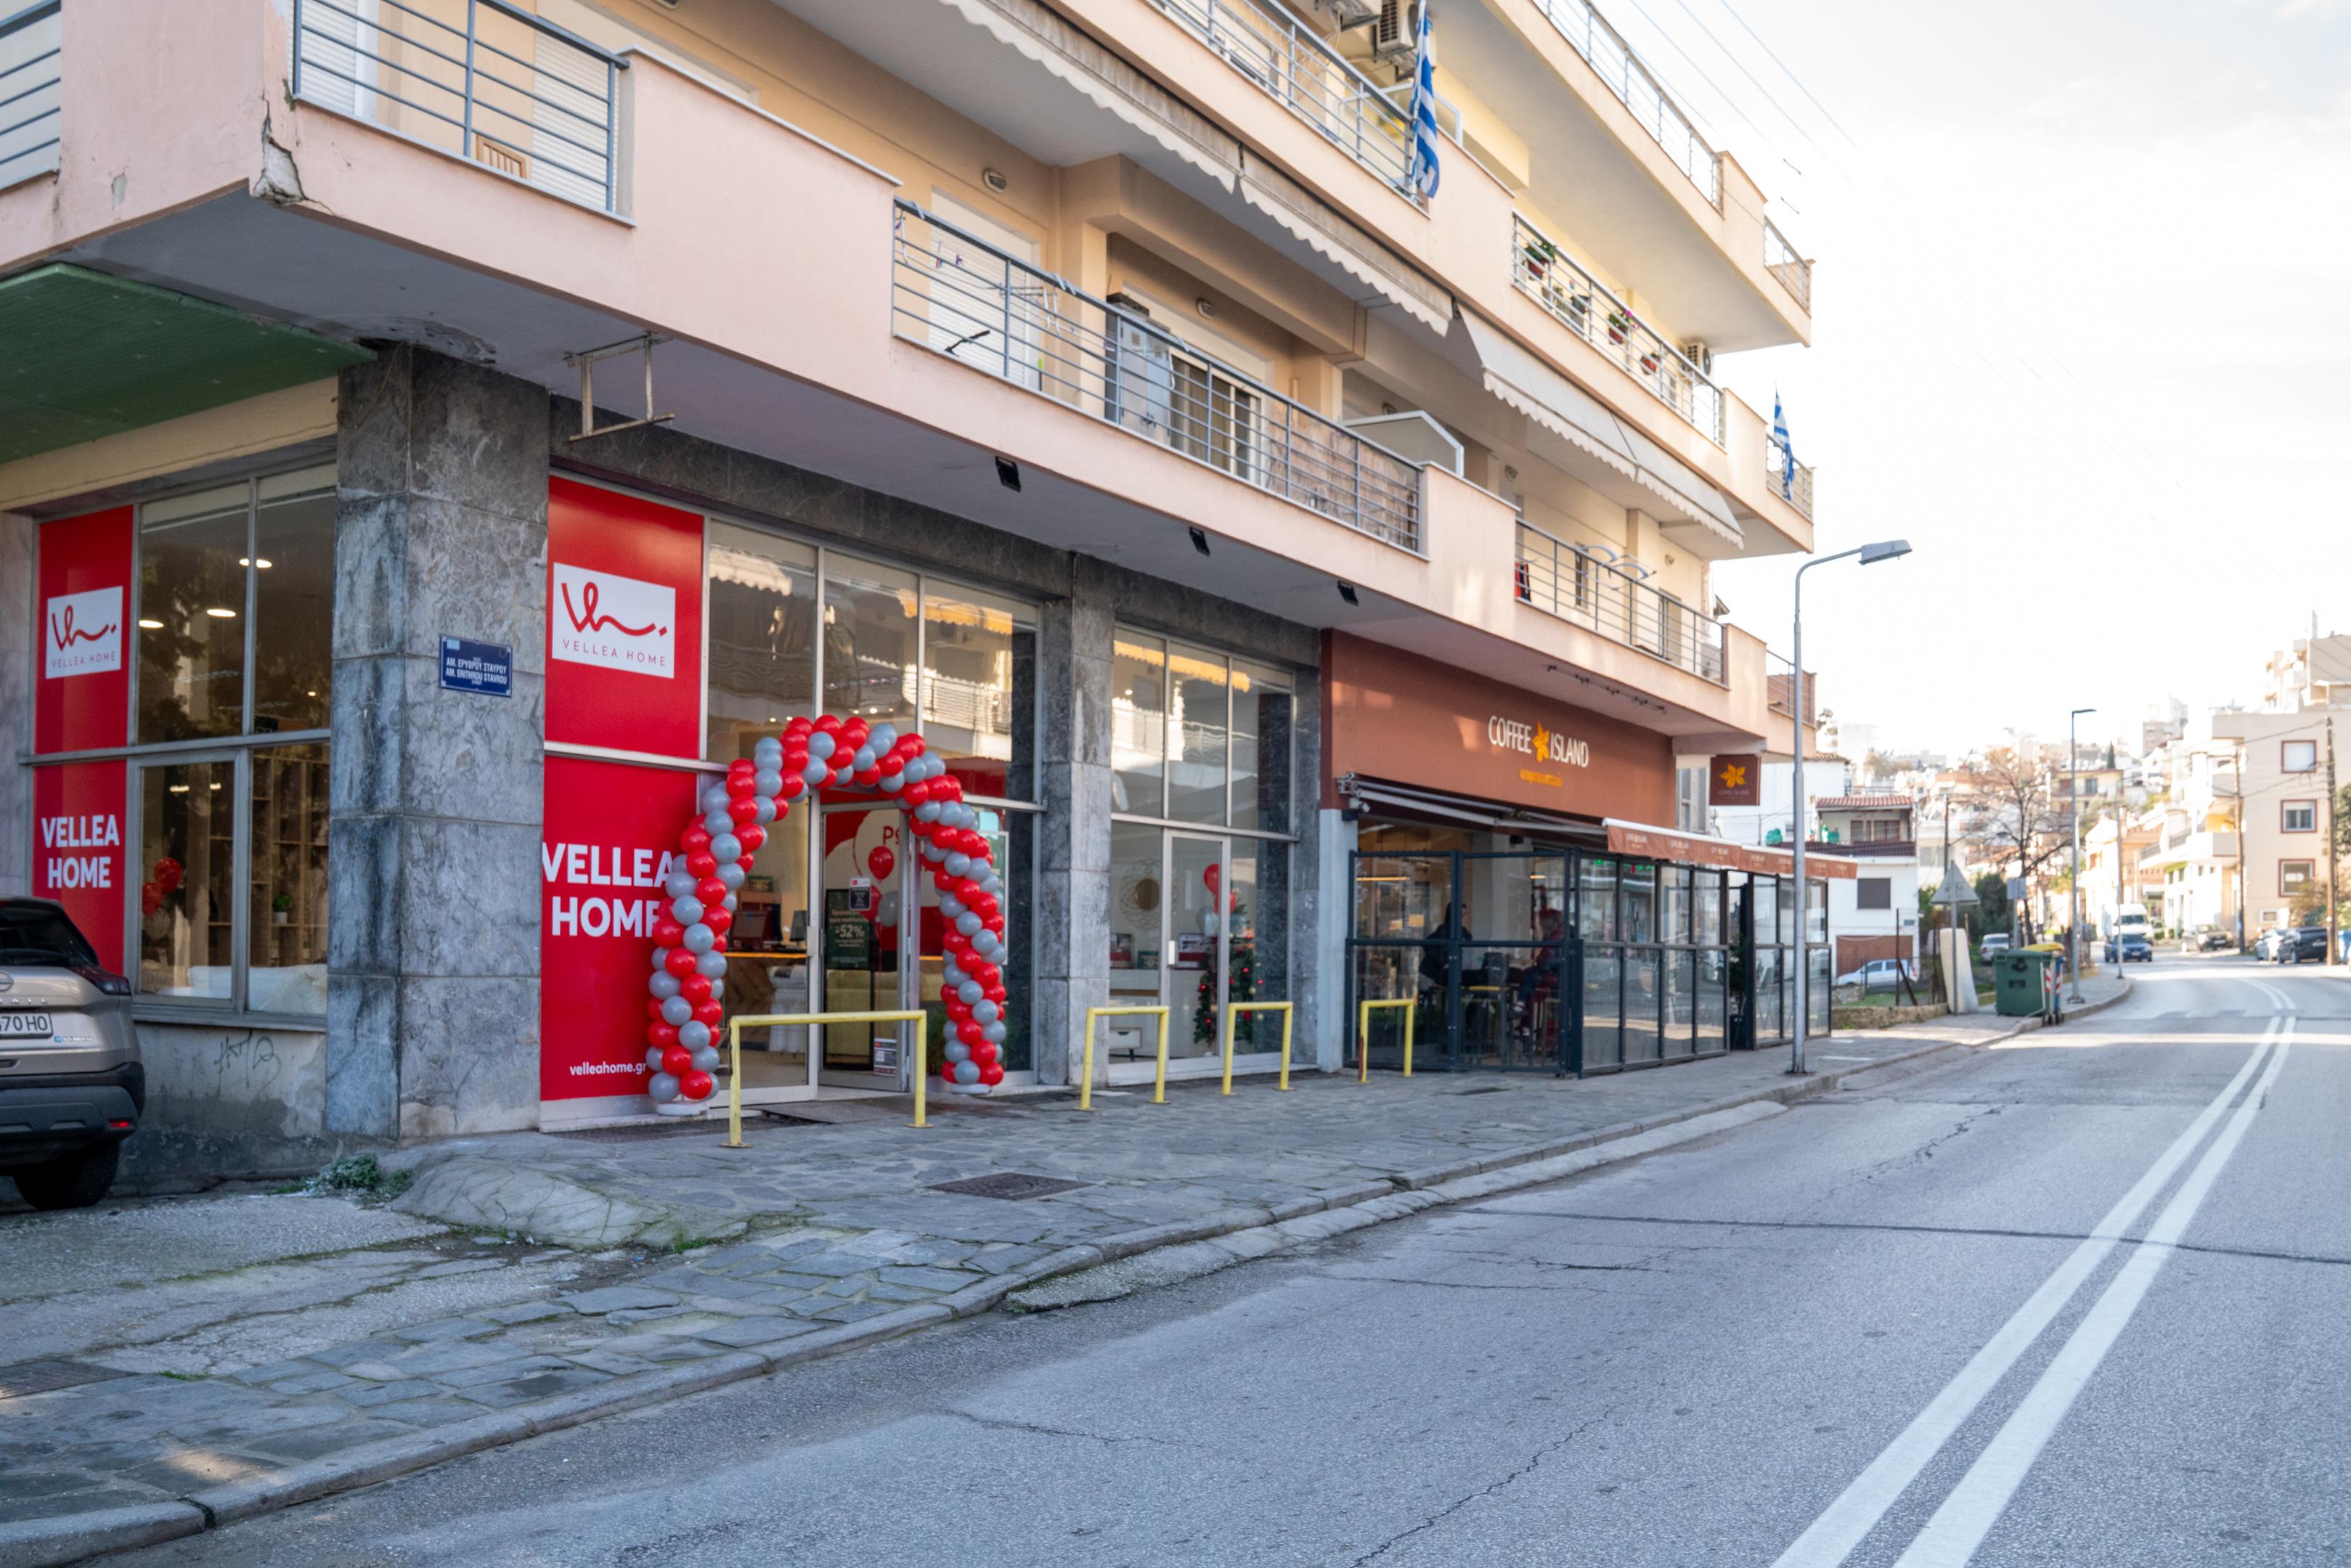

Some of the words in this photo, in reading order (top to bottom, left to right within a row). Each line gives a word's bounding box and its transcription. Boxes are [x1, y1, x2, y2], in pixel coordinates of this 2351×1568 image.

[52, 656, 85, 669] VELLEA
[89, 651, 116, 663] HOME
[563, 638, 618, 658] VELLEA
[627, 650, 666, 666] HOME
[457, 669, 483, 681] ERITHROU
[483, 673, 508, 685] STAVROU
[483, 662, 507, 674] ΣΤΑΥΡΟΥ
[1488, 715, 1533, 754] COFFEE
[1550, 732, 1589, 767] ISLAND
[41, 814, 120, 848] VELLEA
[48, 857, 111, 889] HOME
[542, 842, 673, 888] VELLEA
[0, 1016, 23, 1032] 70
[25, 1016, 48, 1032] HO
[569, 1061, 647, 1076] velleahome.gr
